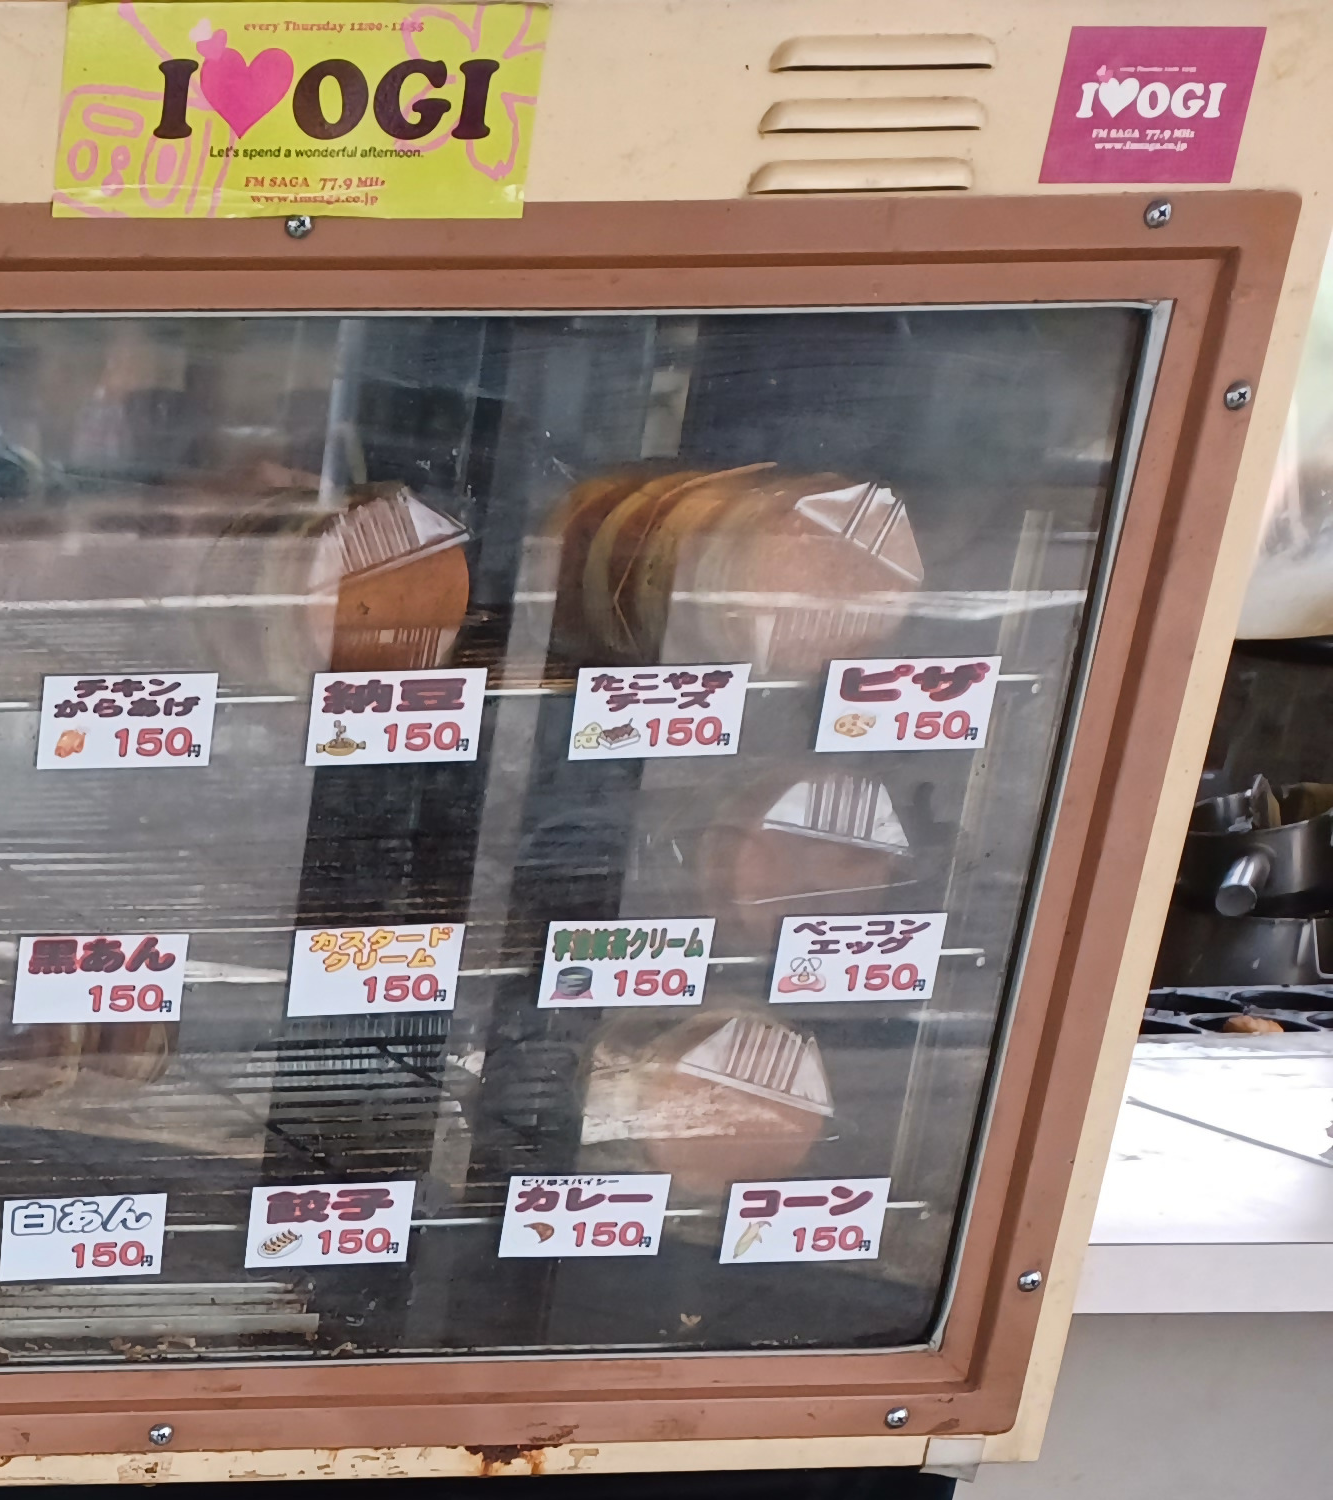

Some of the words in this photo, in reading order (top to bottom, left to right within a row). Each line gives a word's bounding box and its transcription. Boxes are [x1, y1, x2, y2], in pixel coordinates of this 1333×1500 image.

[283, 21, 345, 33] Thursday
[153, 58, 200, 140] I
[293, 58, 500, 140] OGI
[1076, 82, 1099, 118] I
[1136, 82, 1227, 118] OGI
[209, 146, 239, 158] Let's
[243, 146, 281, 160] spend
[284, 150, 291, 158] a
[295, 146, 357, 158] wonderful
[360, 146, 425, 158] afternoon.
[244, 176, 265, 188] FM
[269, 176, 310, 188] SAGA
[319, 177, 353, 190] 77.9
[73, 678, 181, 698] チキン
[321, 677, 467, 714] 納豆
[590, 670, 734, 692] たこやき
[840, 662, 991, 702] ピザ
[54, 696, 201, 718] からあげ
[606, 688, 716, 712] チーズ
[383, 721, 470, 753] 150円
[645, 716, 730, 747] 150円
[894, 710, 979, 740] 150円
[114, 726, 201, 758] 150円
[309, 926, 454, 953] カスタード
[793, 919, 932, 936] ベーコン
[28, 936, 176, 974] 黒あん
[807, 934, 914, 954] エッグ
[323, 948, 436, 972] クリーム
[363, 973, 447, 1003] 150円
[614, 968, 696, 997] 150円
[845, 963, 926, 992] 150円
[88, 983, 172, 1013] 150円
[266, 1188, 395, 1224] 餃子
[514, 1186, 654, 1212] カレー
[739, 1185, 874, 1218] コーン
[11, 1196, 153, 1236] 白あん
[318, 1227, 400, 1255] 150円
[572, 1221, 652, 1248] 150円
[792, 1225, 871, 1253] 150円
[71, 1240, 154, 1269] 150円
